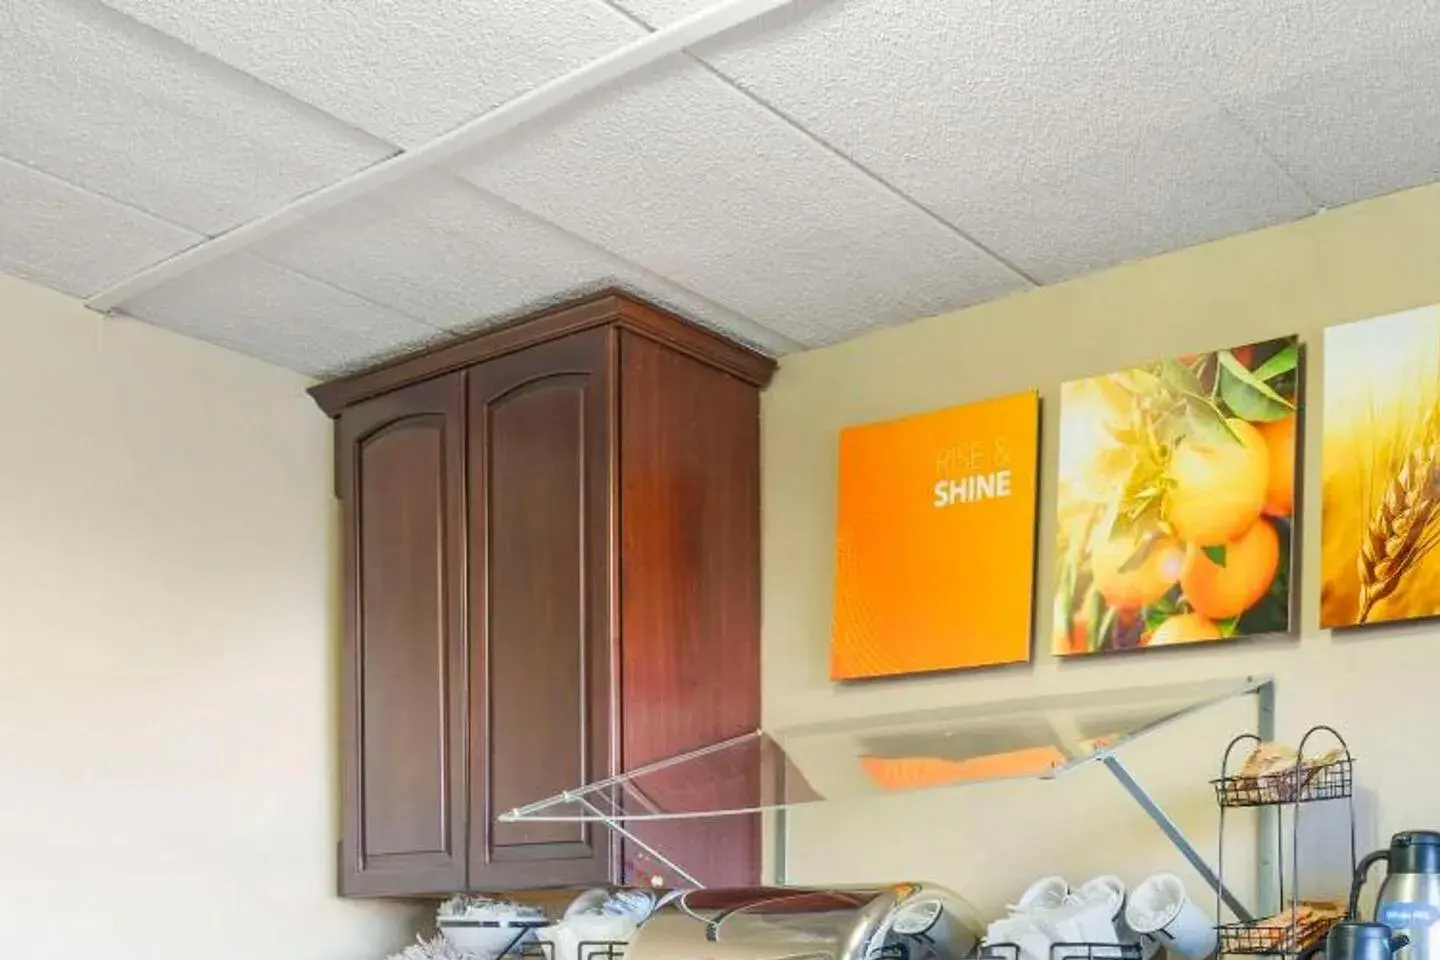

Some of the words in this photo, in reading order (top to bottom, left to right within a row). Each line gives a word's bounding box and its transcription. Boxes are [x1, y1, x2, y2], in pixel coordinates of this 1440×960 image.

[935, 440, 985, 479] RISE
[993, 437, 1011, 466] &
[933, 469, 1012, 508] SHINE
